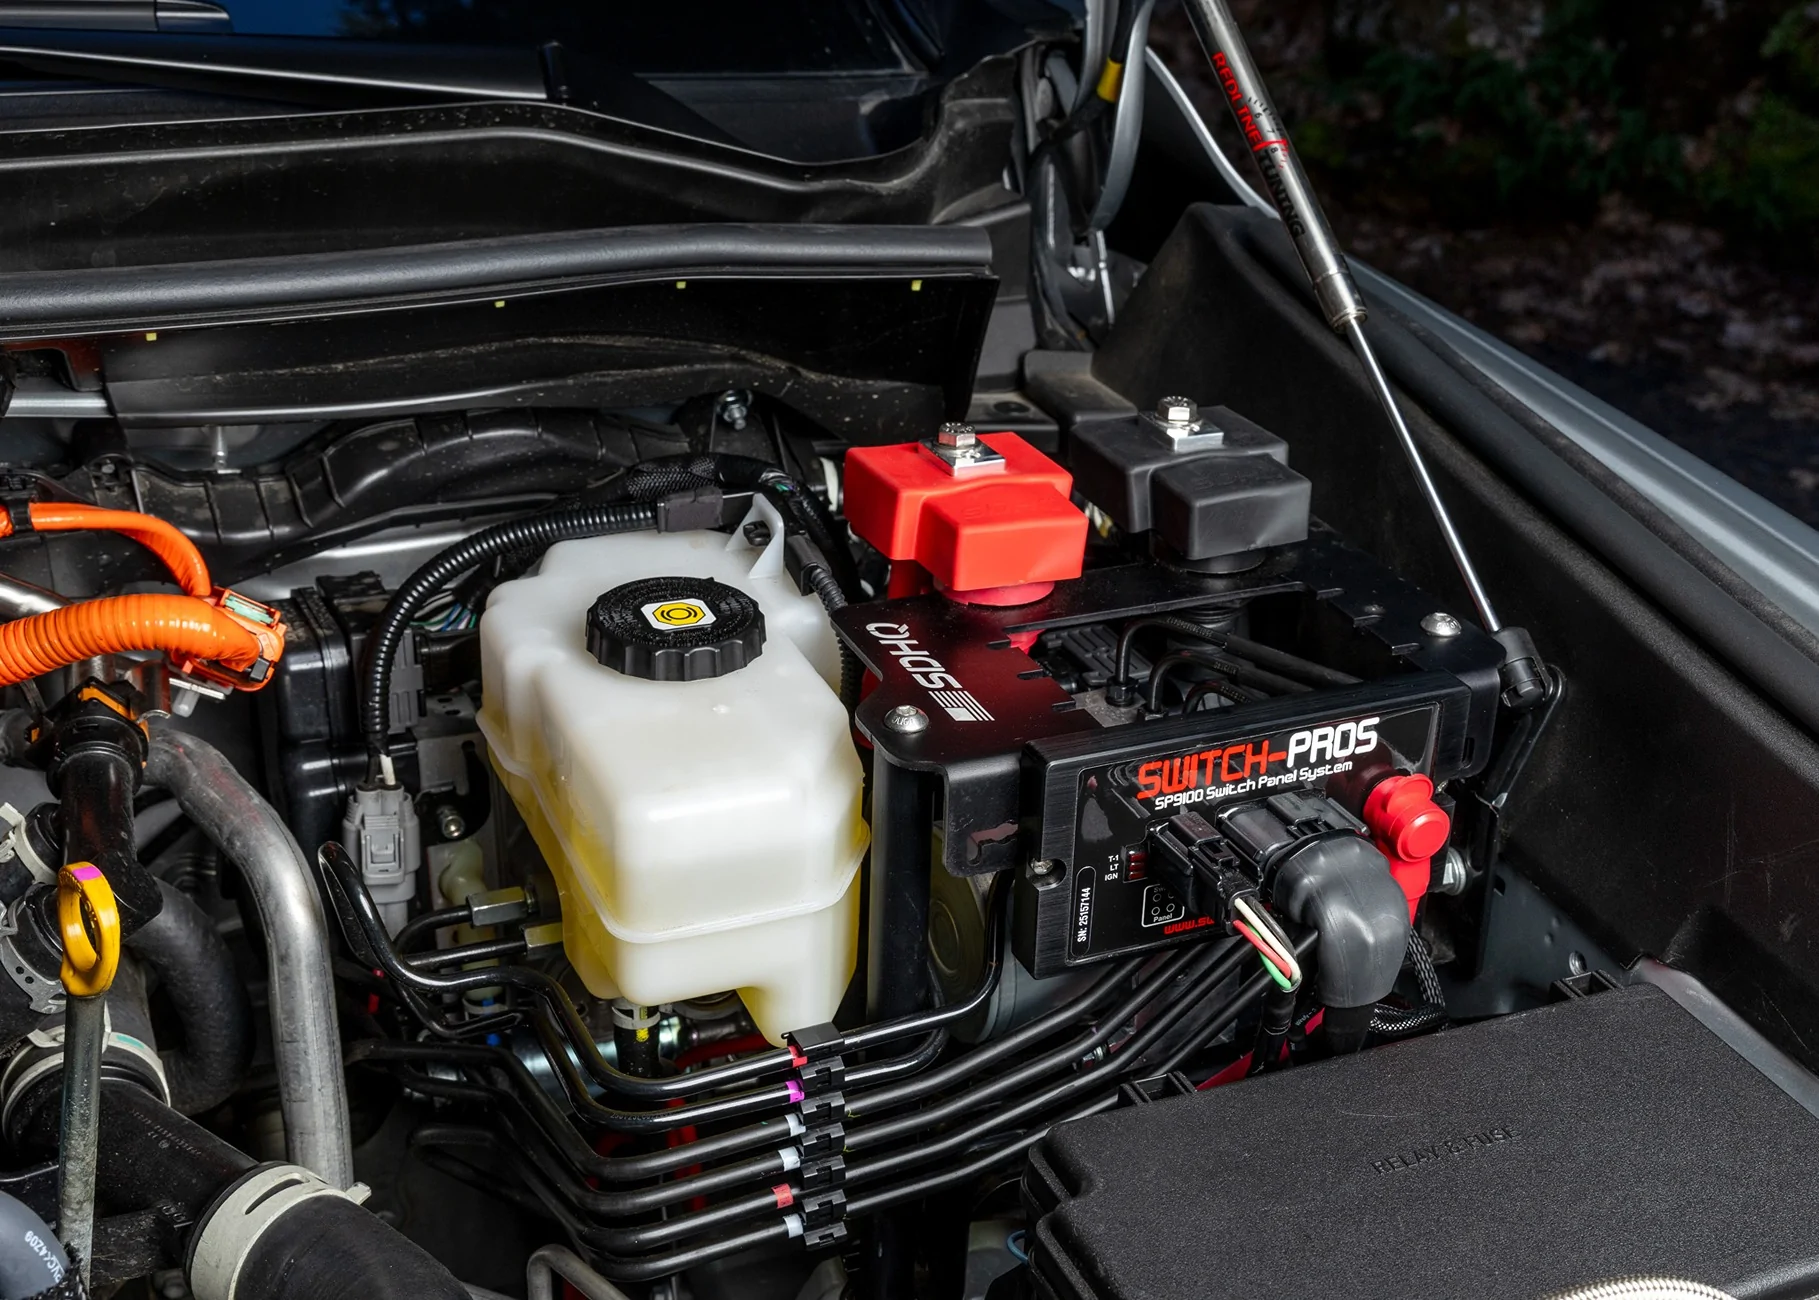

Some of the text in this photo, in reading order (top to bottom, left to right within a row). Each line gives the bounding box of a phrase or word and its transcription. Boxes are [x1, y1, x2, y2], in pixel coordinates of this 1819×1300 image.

[1212, 51, 1305, 239] REDLINE TUNING
[865, 622, 963, 689] SDHQ
[1137, 717, 1380, 800] SWITCH-PROS
[1155, 761, 1353, 810] SP9100 Switch Panel System
[1104, 872, 1118, 881] IGN
[1108, 854, 1119, 862] T-1
[1109, 863, 1119, 871] LT
[1077, 887, 1091, 943] SN: 25157144
[1153, 913, 1173, 923] Panel
[1370, 1146, 1441, 1175] RELAY
[1463, 1127, 1521, 1150] FUSE
